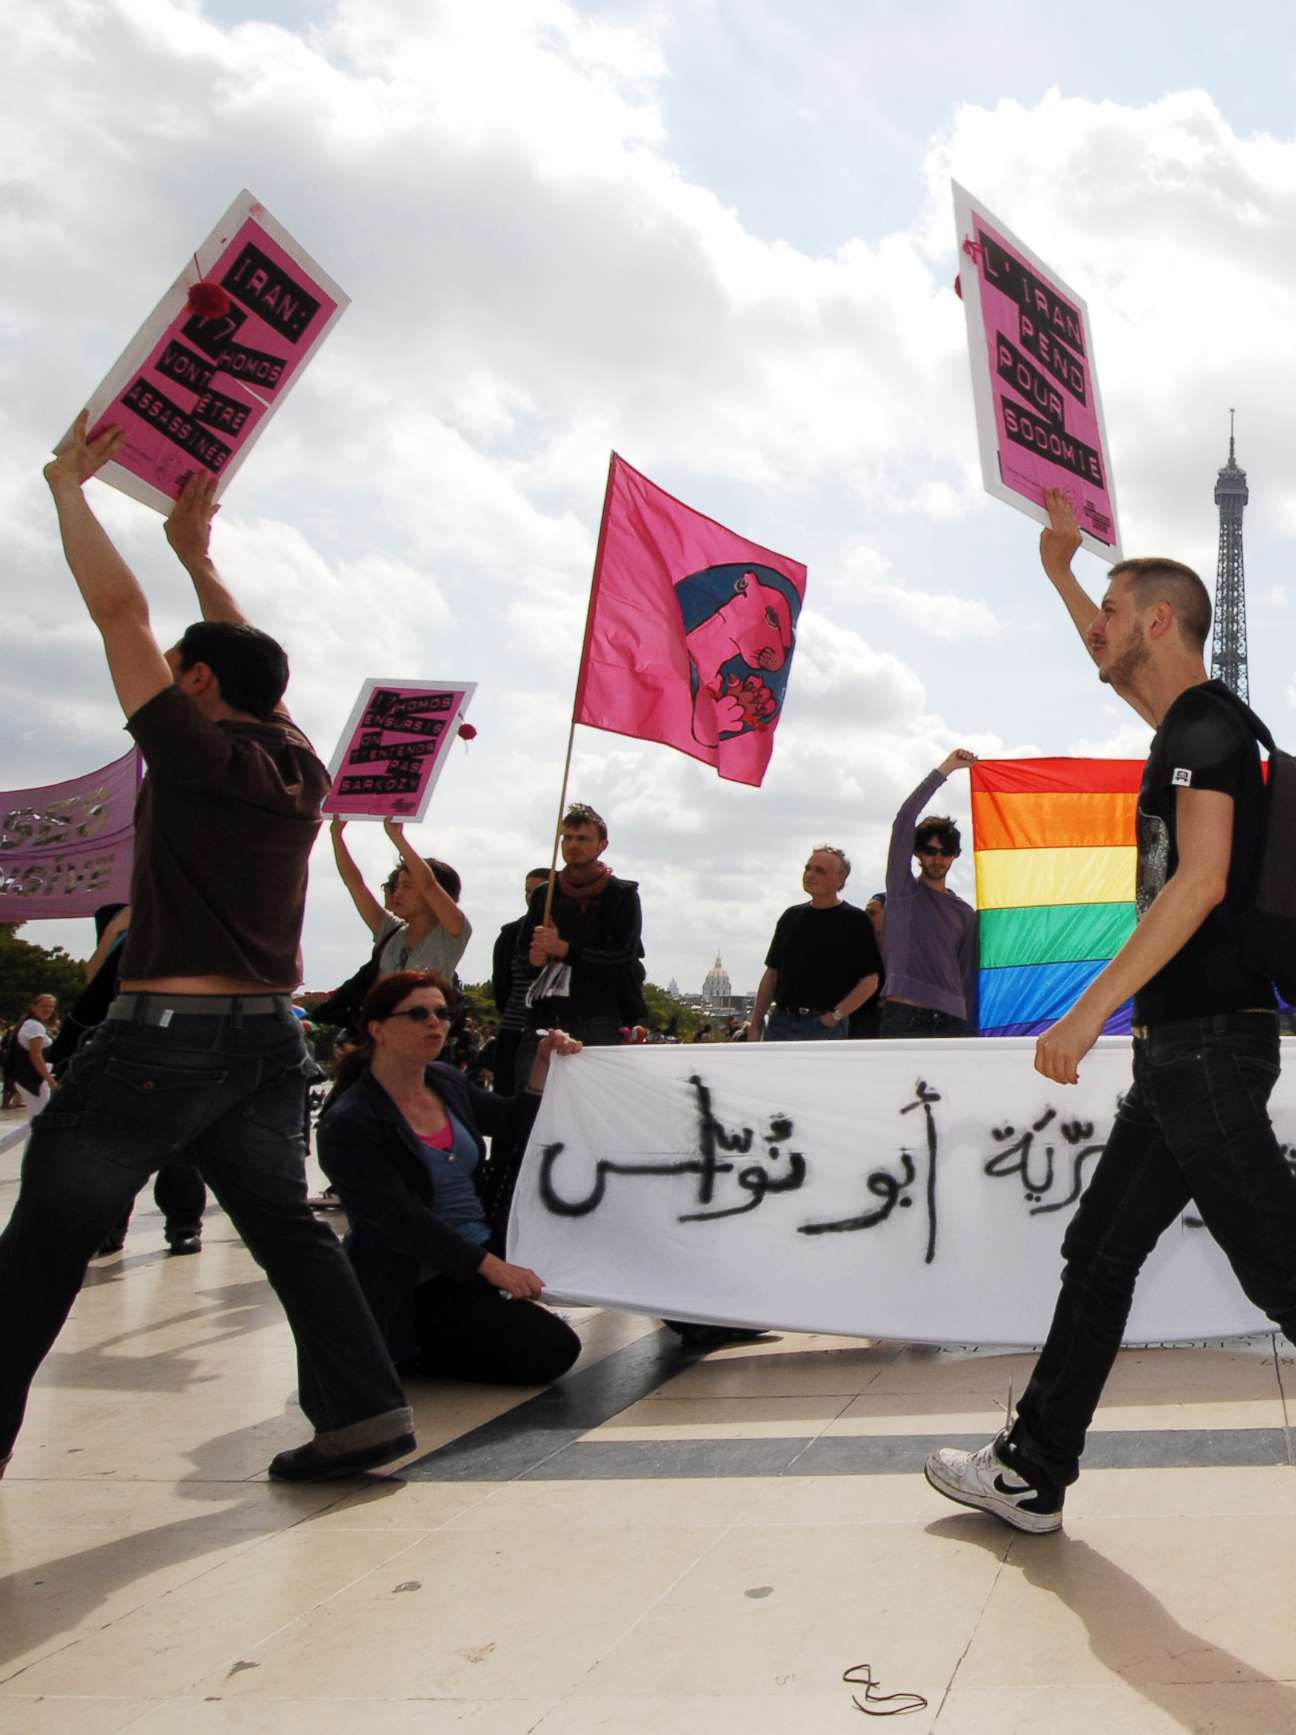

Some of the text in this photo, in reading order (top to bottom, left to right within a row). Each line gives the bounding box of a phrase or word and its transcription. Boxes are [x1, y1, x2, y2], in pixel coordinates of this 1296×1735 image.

[161, 347, 213, 385] VONT
[219, 347, 284, 384] HOMOS
[1020, 315, 1085, 393] PEND
[998, 346, 1064, 422] POUR
[1005, 410, 1100, 479] SODOMIE
[391, 759, 421, 772] PAS
[341, 778, 418, 792] SARKOZY
